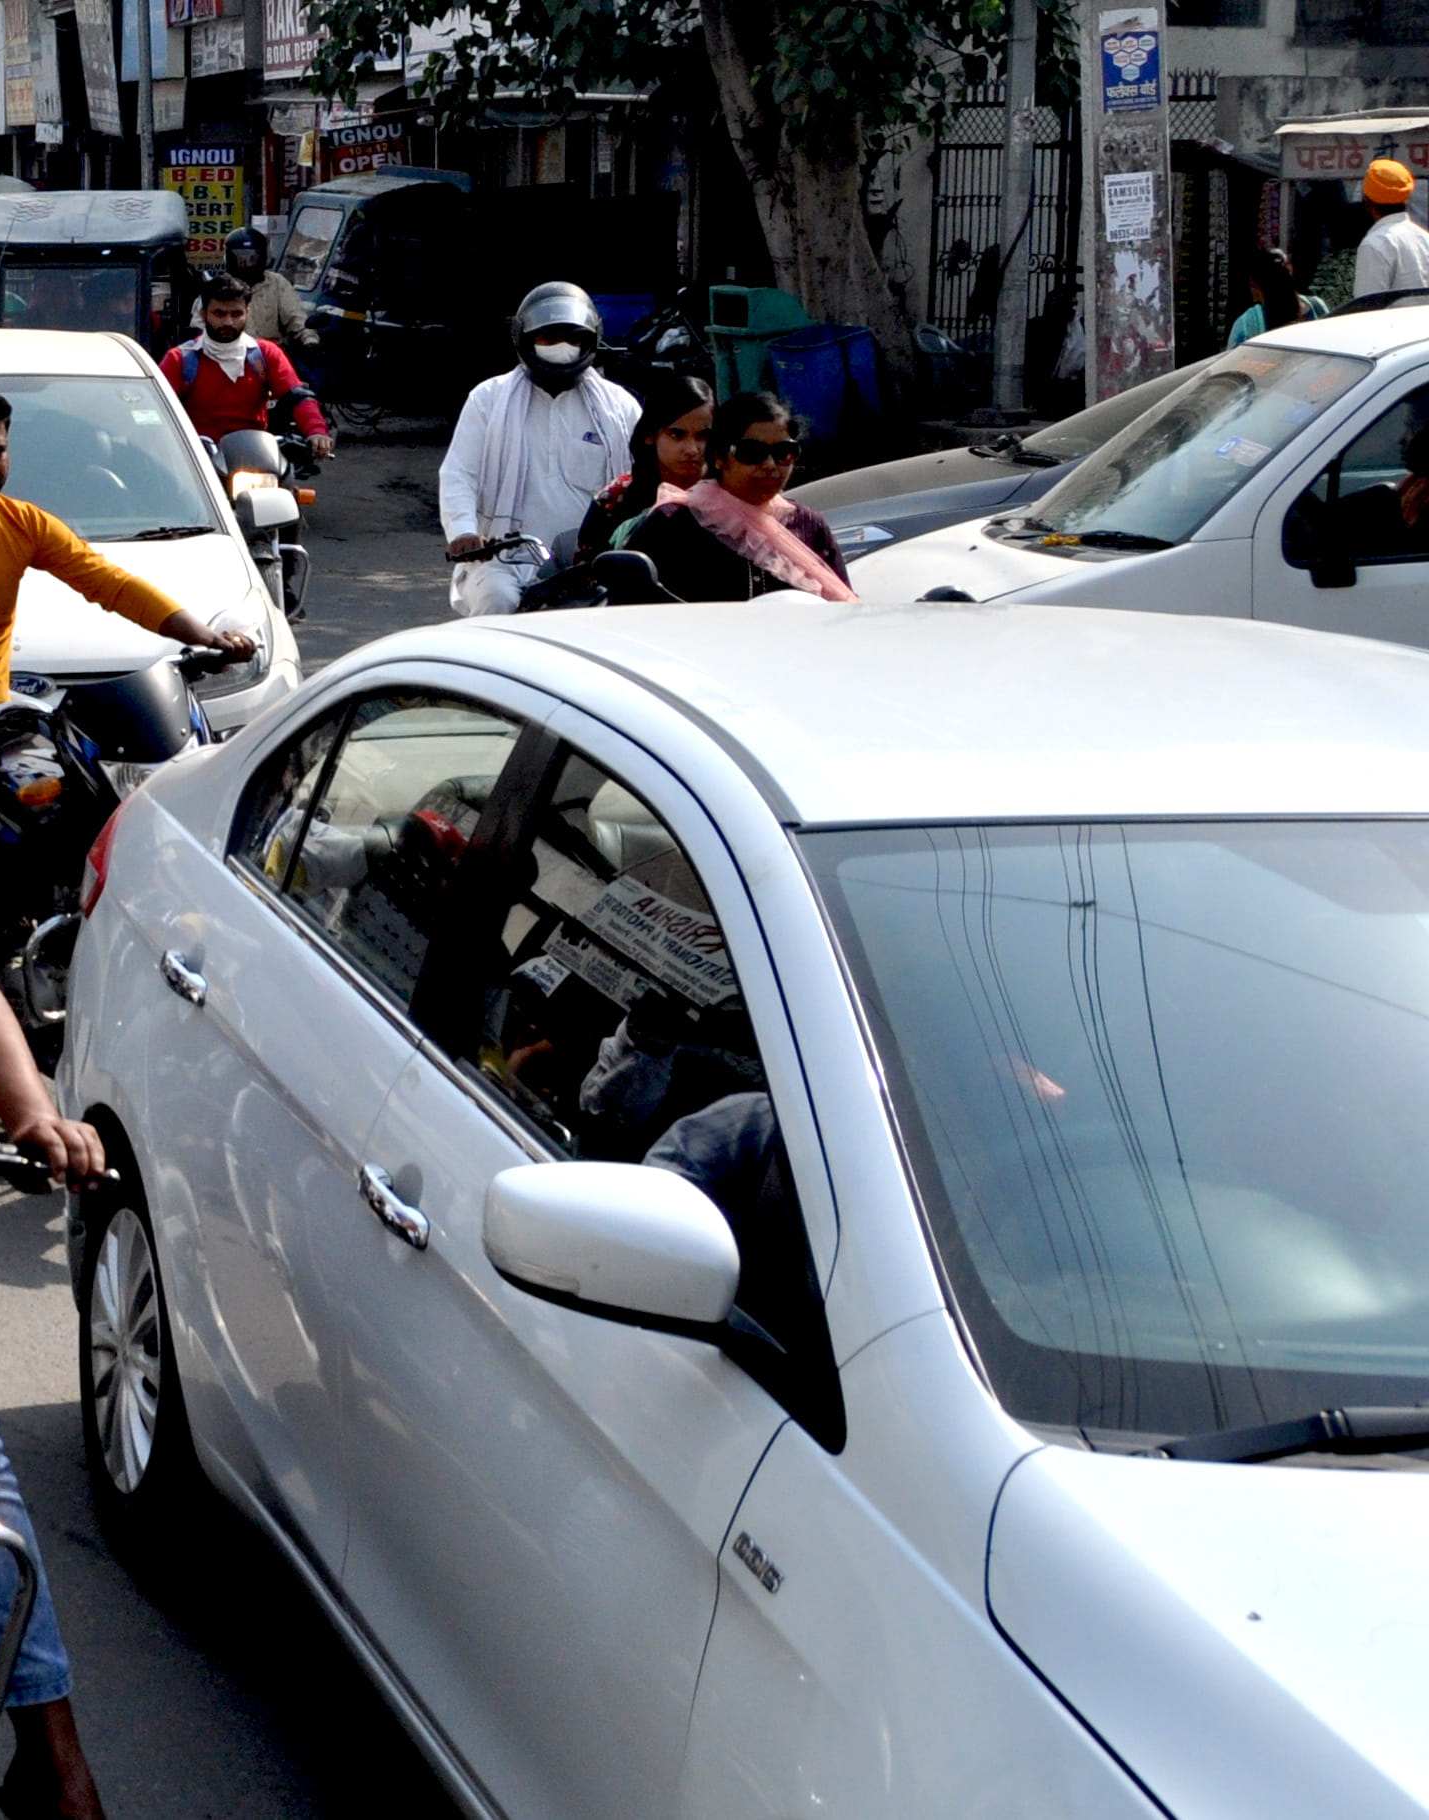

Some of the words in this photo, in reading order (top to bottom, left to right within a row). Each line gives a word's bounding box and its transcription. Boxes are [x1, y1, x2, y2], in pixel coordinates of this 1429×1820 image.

[265, 41, 293, 65] BOOK
[333, 122, 403, 147] IGNOU
[169, 148, 236, 166] IGNOU
[338, 151, 403, 174] OPEN
[172, 168, 234, 182] B.ED
[1106, 185, 1151, 199] SAMSUNG
[185, 202, 235, 217] CERT
[188, 220, 234, 234] BSE
